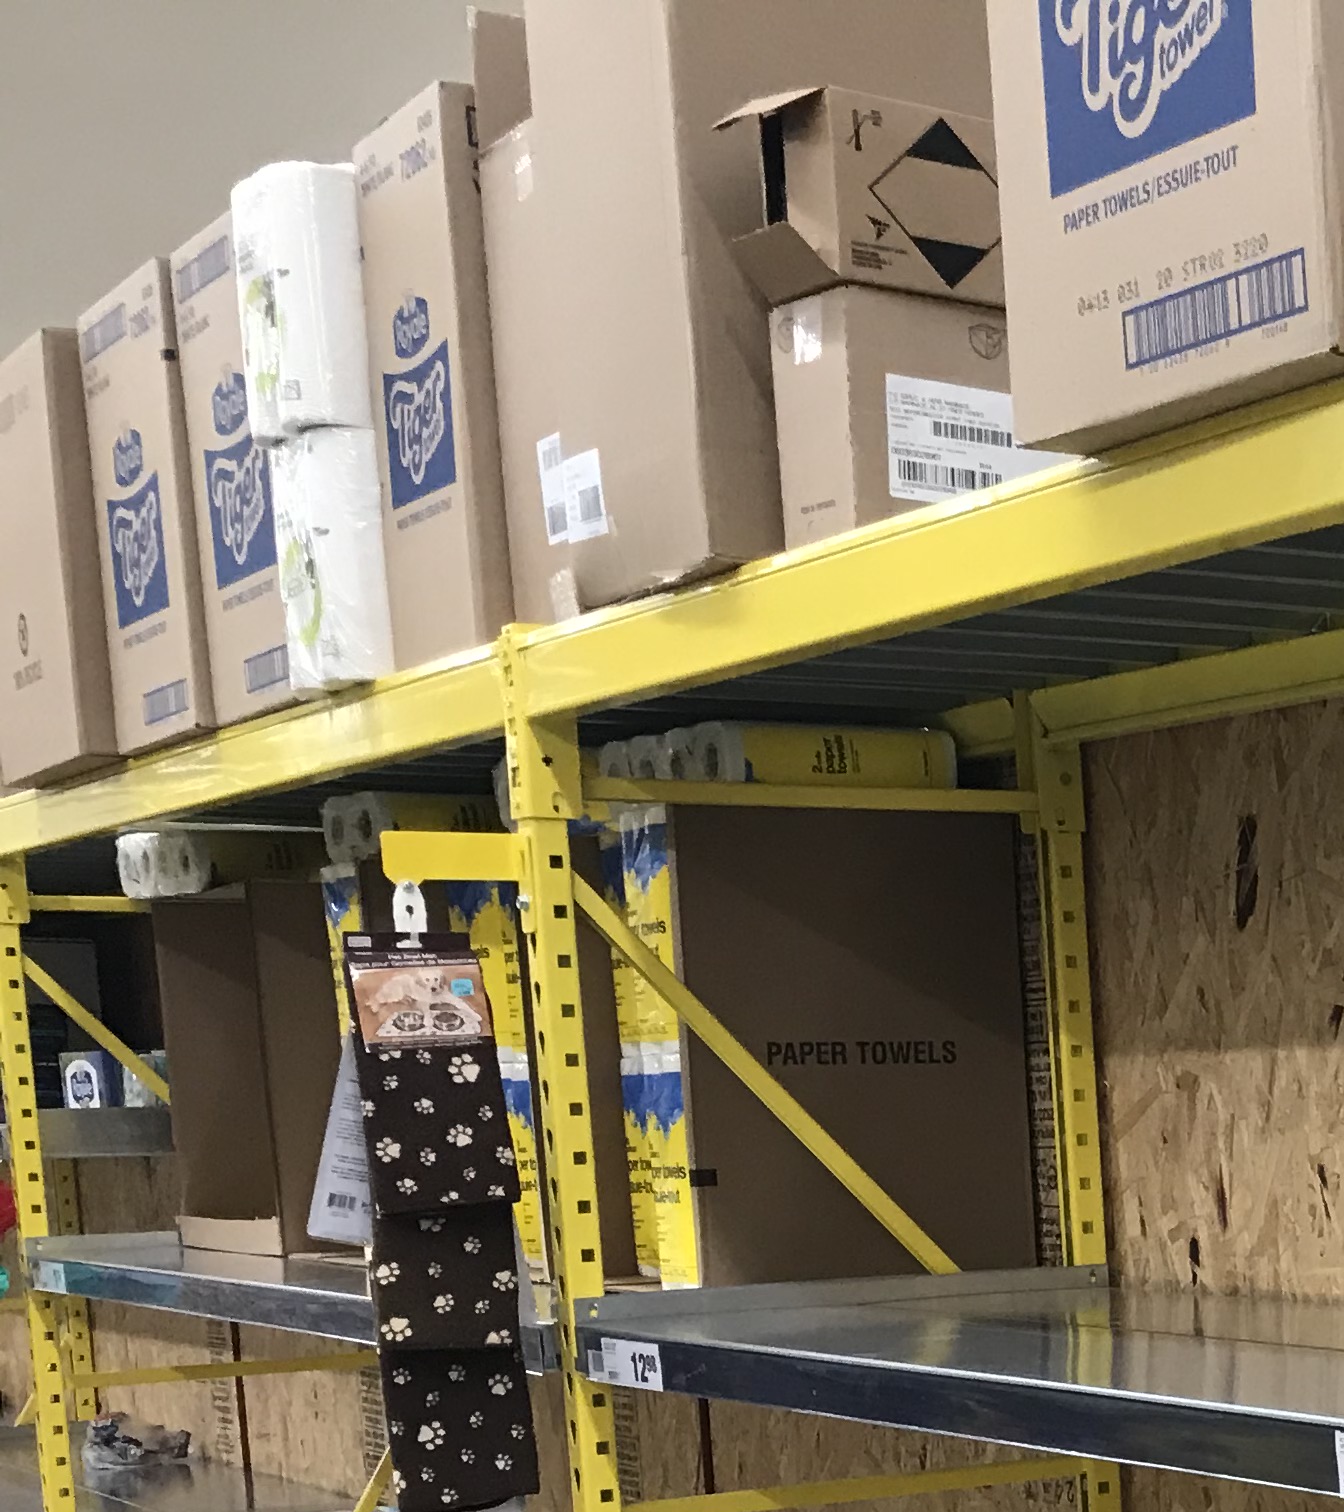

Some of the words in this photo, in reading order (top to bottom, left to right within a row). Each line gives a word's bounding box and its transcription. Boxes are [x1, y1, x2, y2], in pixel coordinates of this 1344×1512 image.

[1064, 203, 1100, 234] PAPER
[766, 1041, 848, 1066] PAPER
[856, 1041, 957, 1066] TOWELS
